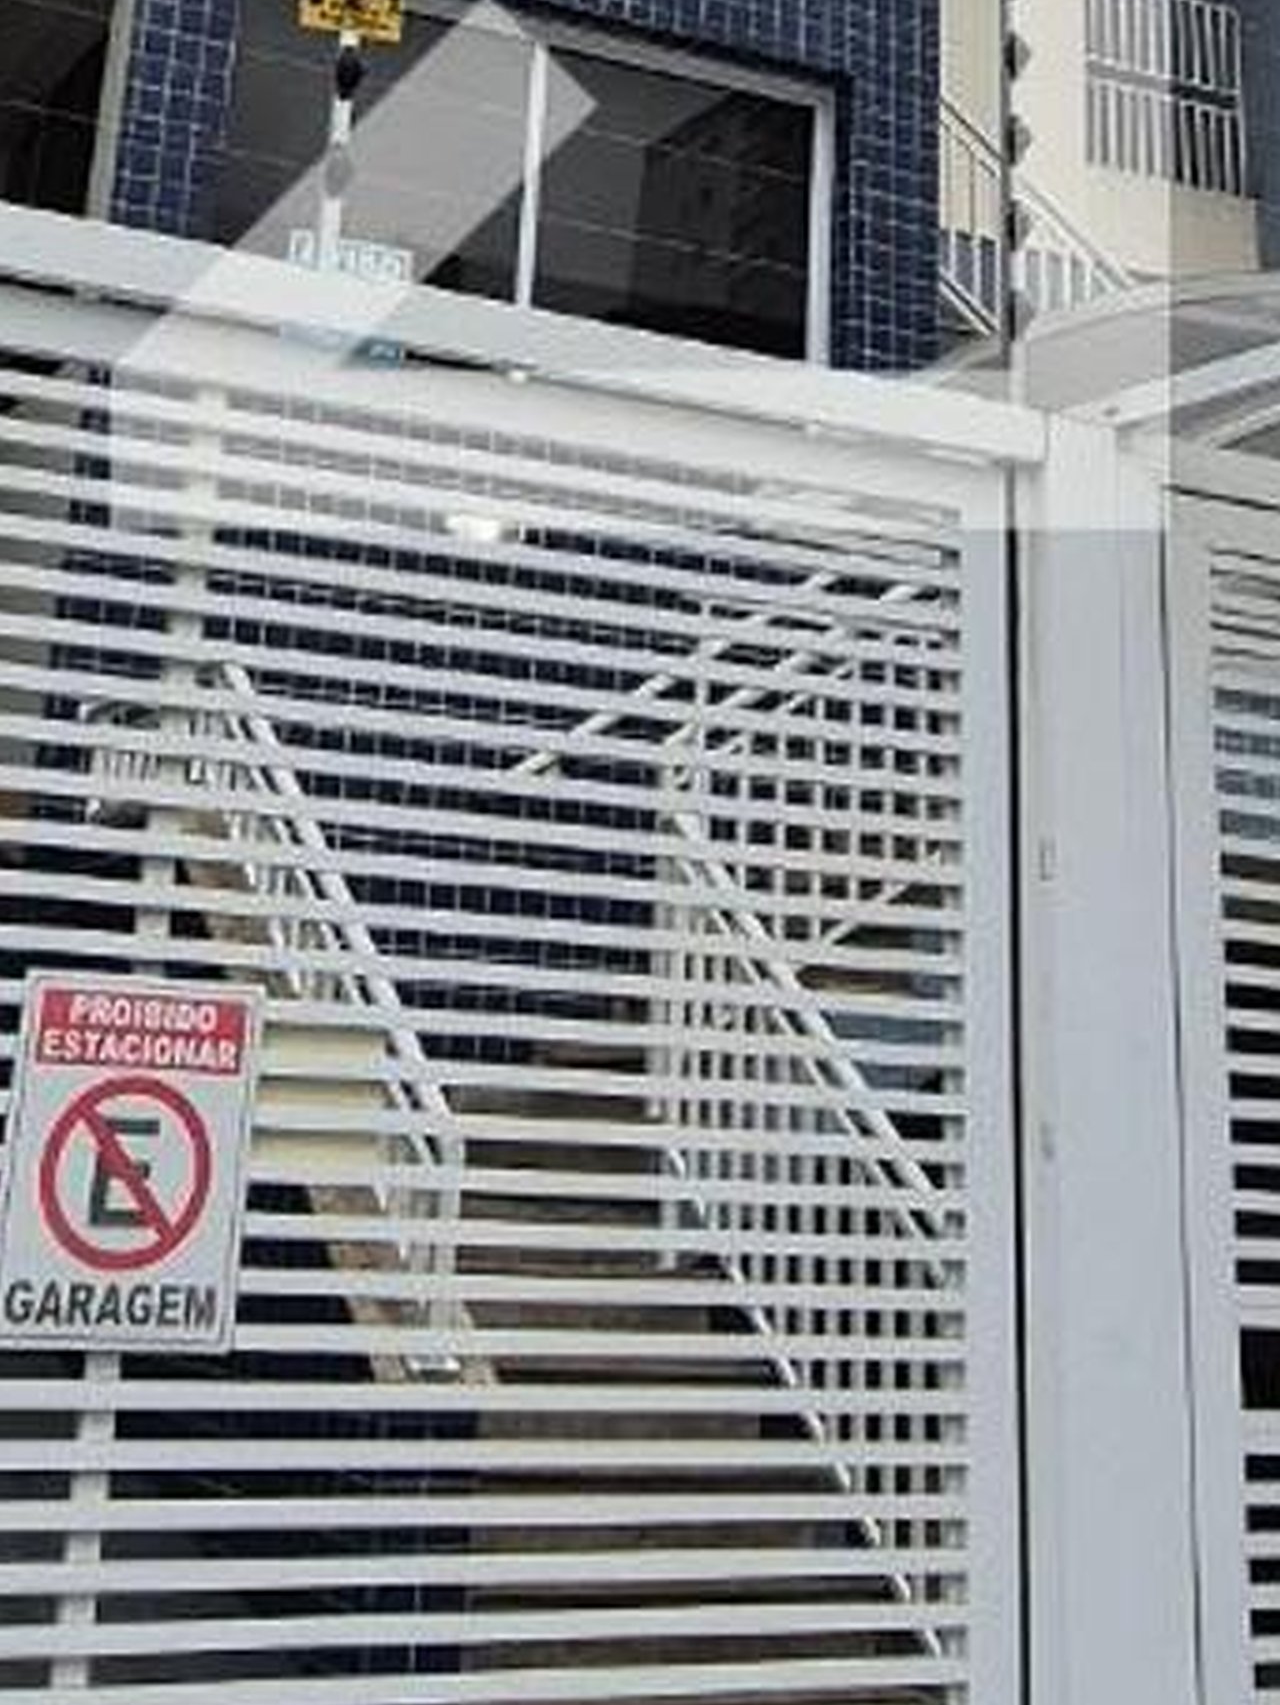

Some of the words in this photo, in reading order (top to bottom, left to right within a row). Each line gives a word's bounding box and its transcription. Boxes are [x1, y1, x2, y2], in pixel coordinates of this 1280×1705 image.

[69, 993, 217, 1033] PROIBIDO
[42, 1029, 237, 1070] ESTACIONAR
[90, 1118, 160, 1228] E
[4, 1279, 216, 1329] GARAGEM
